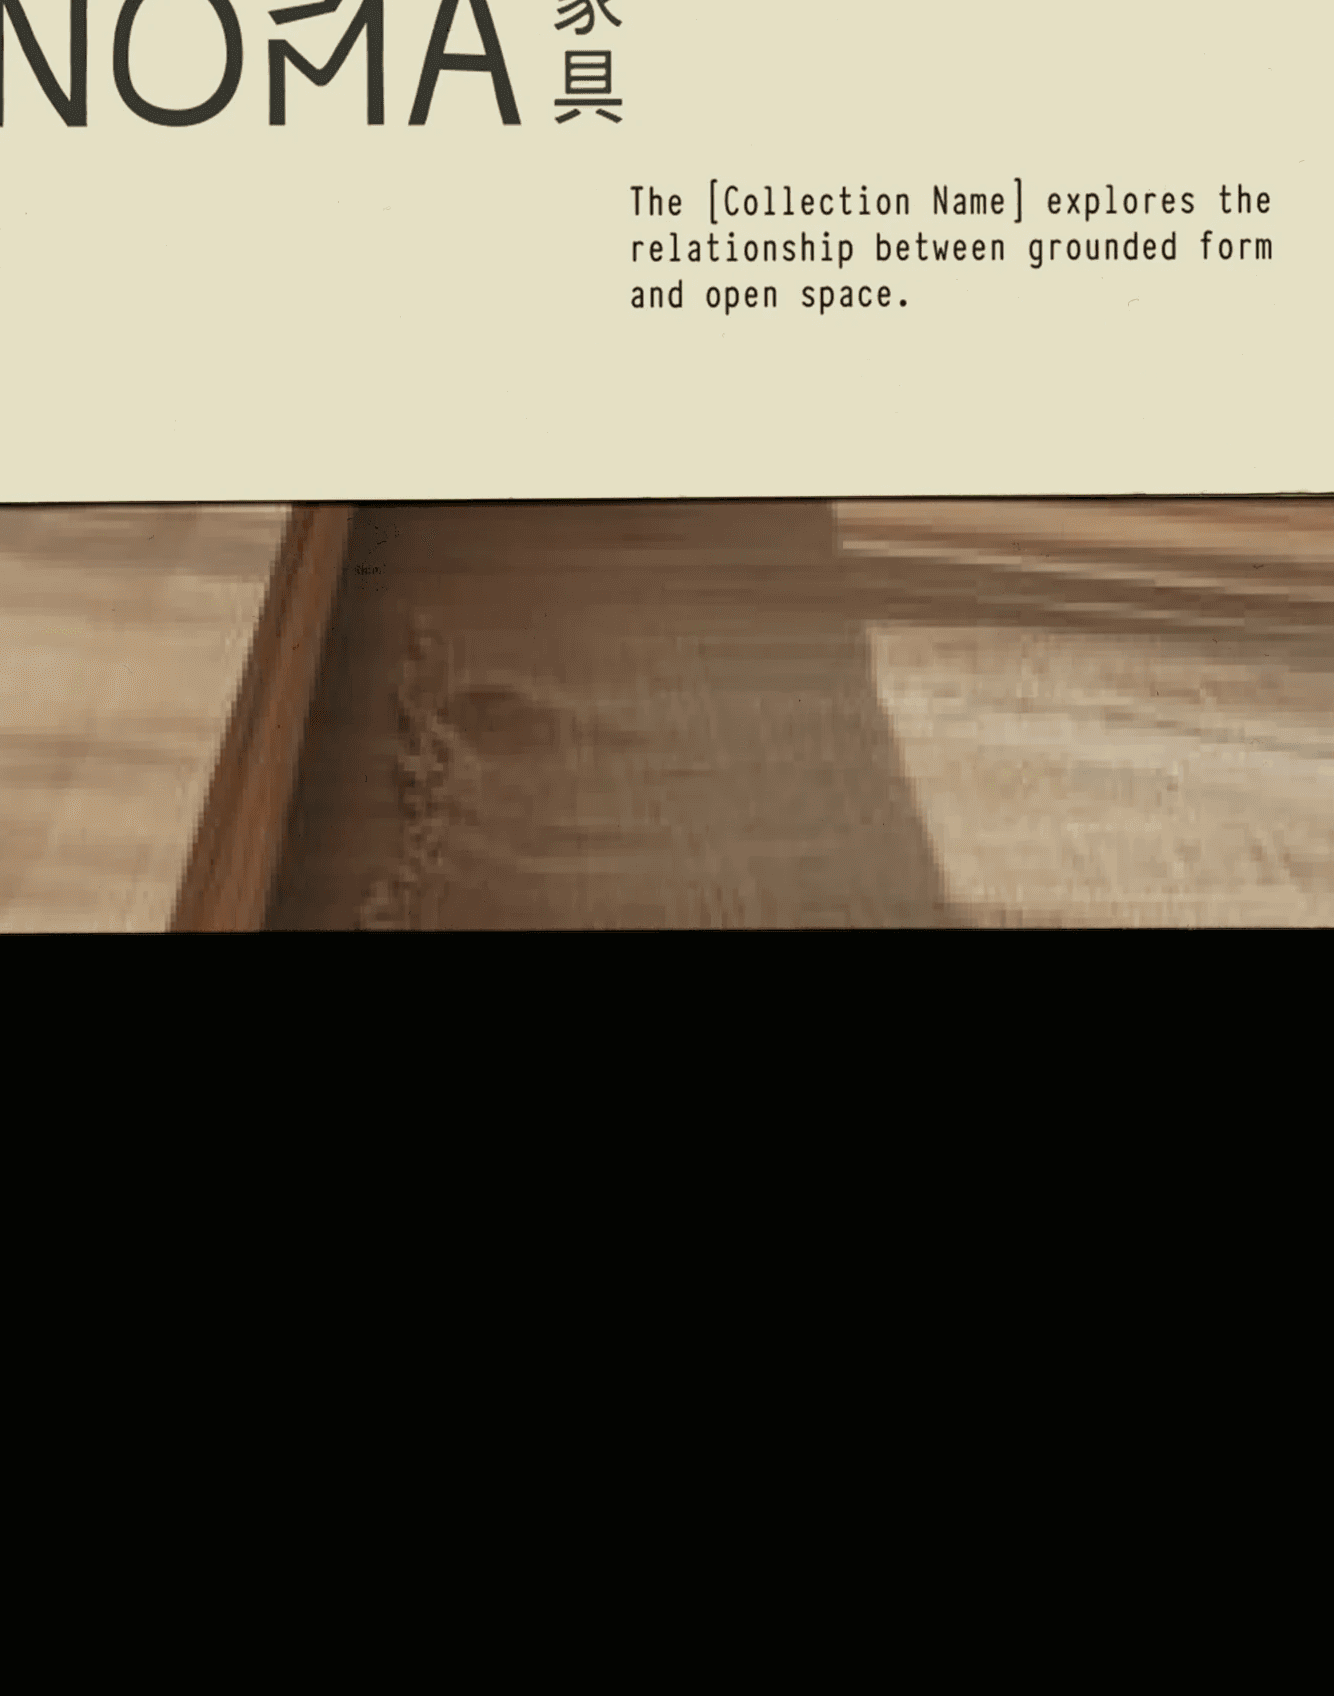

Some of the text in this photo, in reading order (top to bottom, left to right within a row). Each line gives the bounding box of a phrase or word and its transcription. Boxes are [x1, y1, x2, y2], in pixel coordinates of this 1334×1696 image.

[629, 176, 1271, 226] The [Collection Name] explores the
[632, 229, 1273, 270] relationship between grounded form
[630, 278, 908, 317] and open space.
